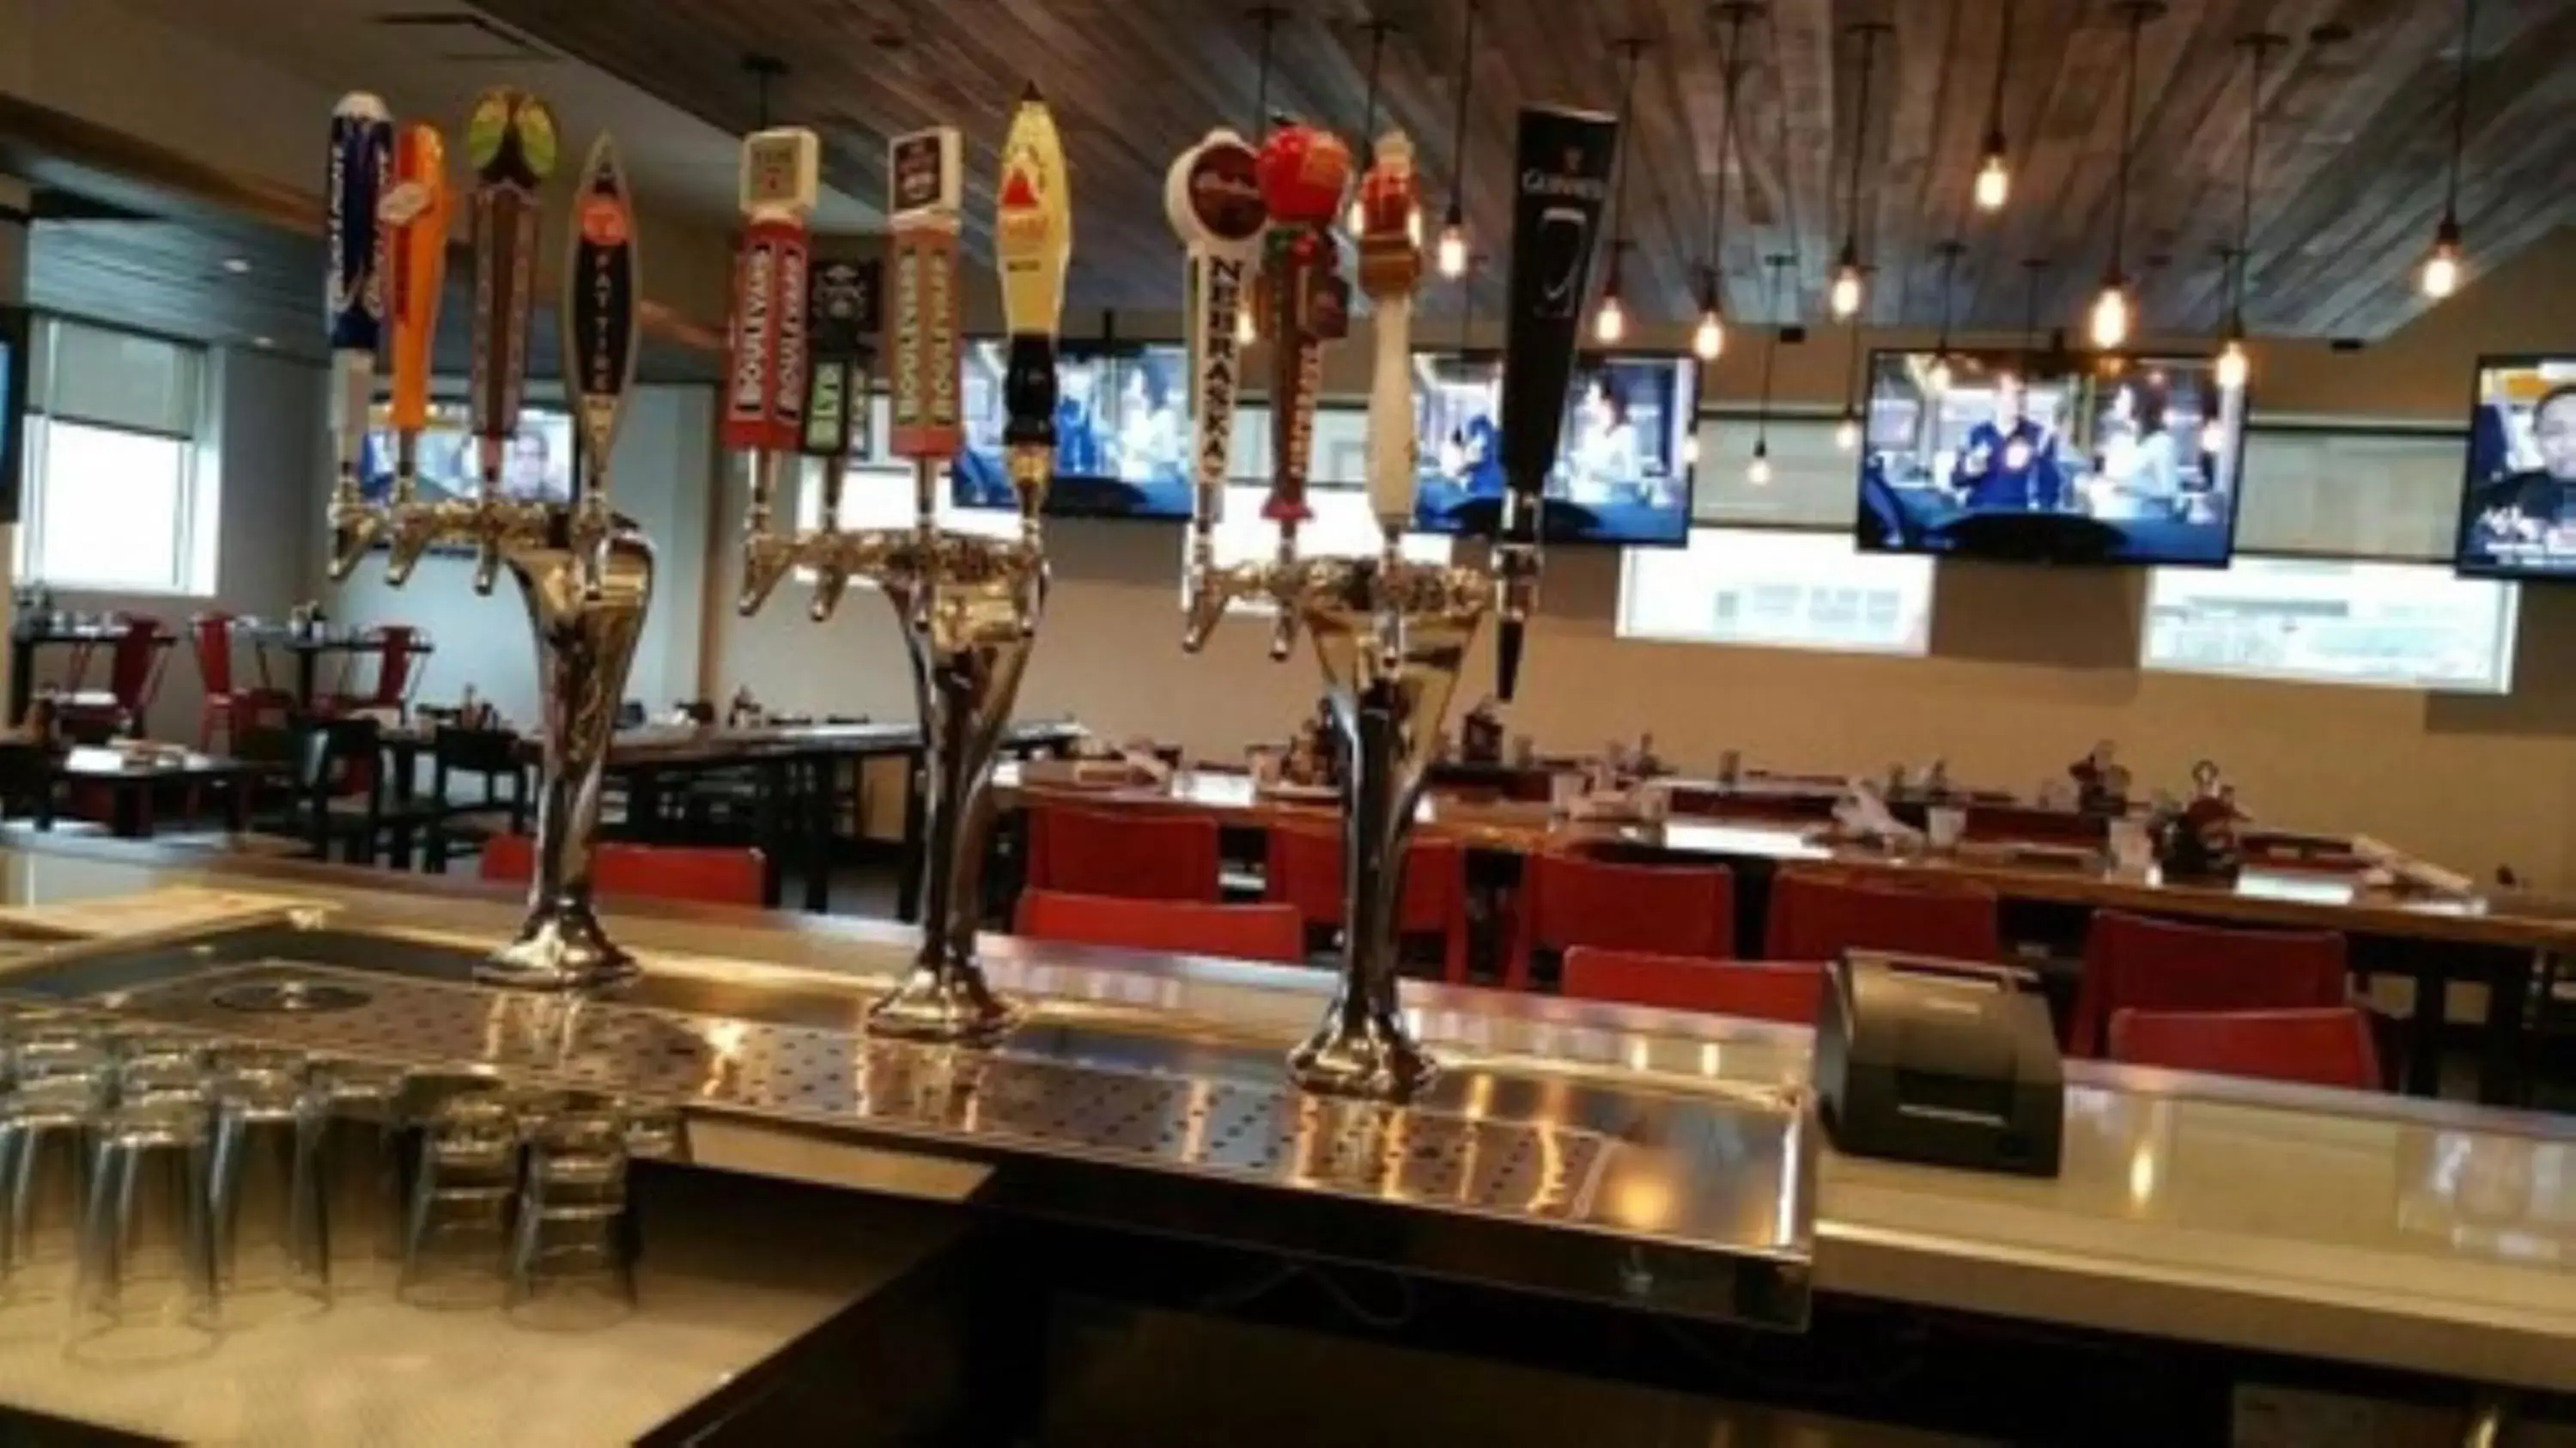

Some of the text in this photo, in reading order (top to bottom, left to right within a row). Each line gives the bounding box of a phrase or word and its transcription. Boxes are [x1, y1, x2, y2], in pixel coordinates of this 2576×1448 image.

[737, 248, 771, 407] BOULEVARD
[896, 253, 920, 417] BOULEVARD
[1202, 259, 1242, 460] NEBRASKA
